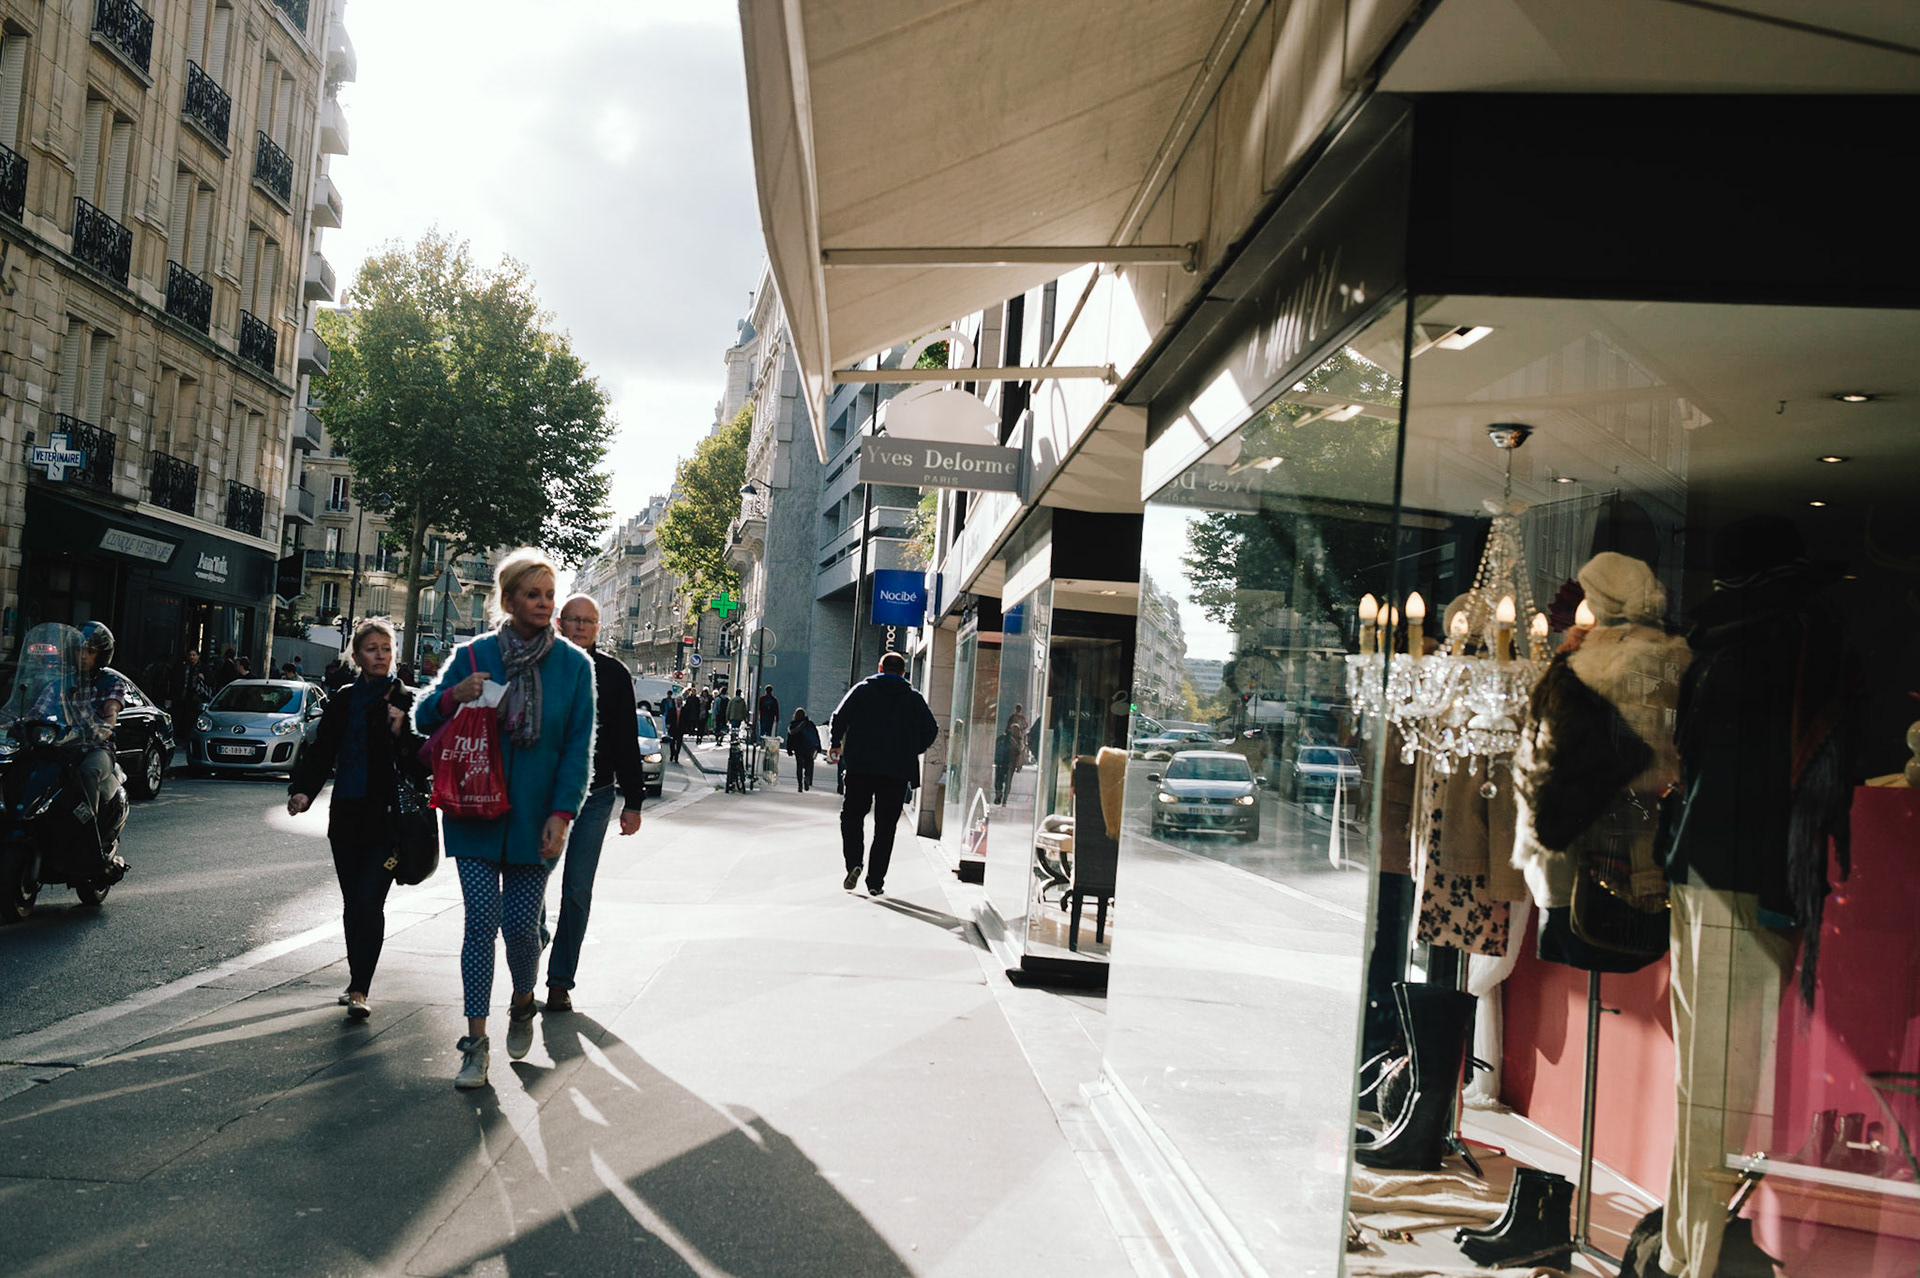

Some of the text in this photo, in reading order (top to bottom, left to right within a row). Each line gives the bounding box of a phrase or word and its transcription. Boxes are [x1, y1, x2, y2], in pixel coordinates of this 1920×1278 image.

[867, 445, 1015, 474] Yves Delorme
[923, 475, 959, 486] PARIS
[880, 589, 917, 602] Nocibé
